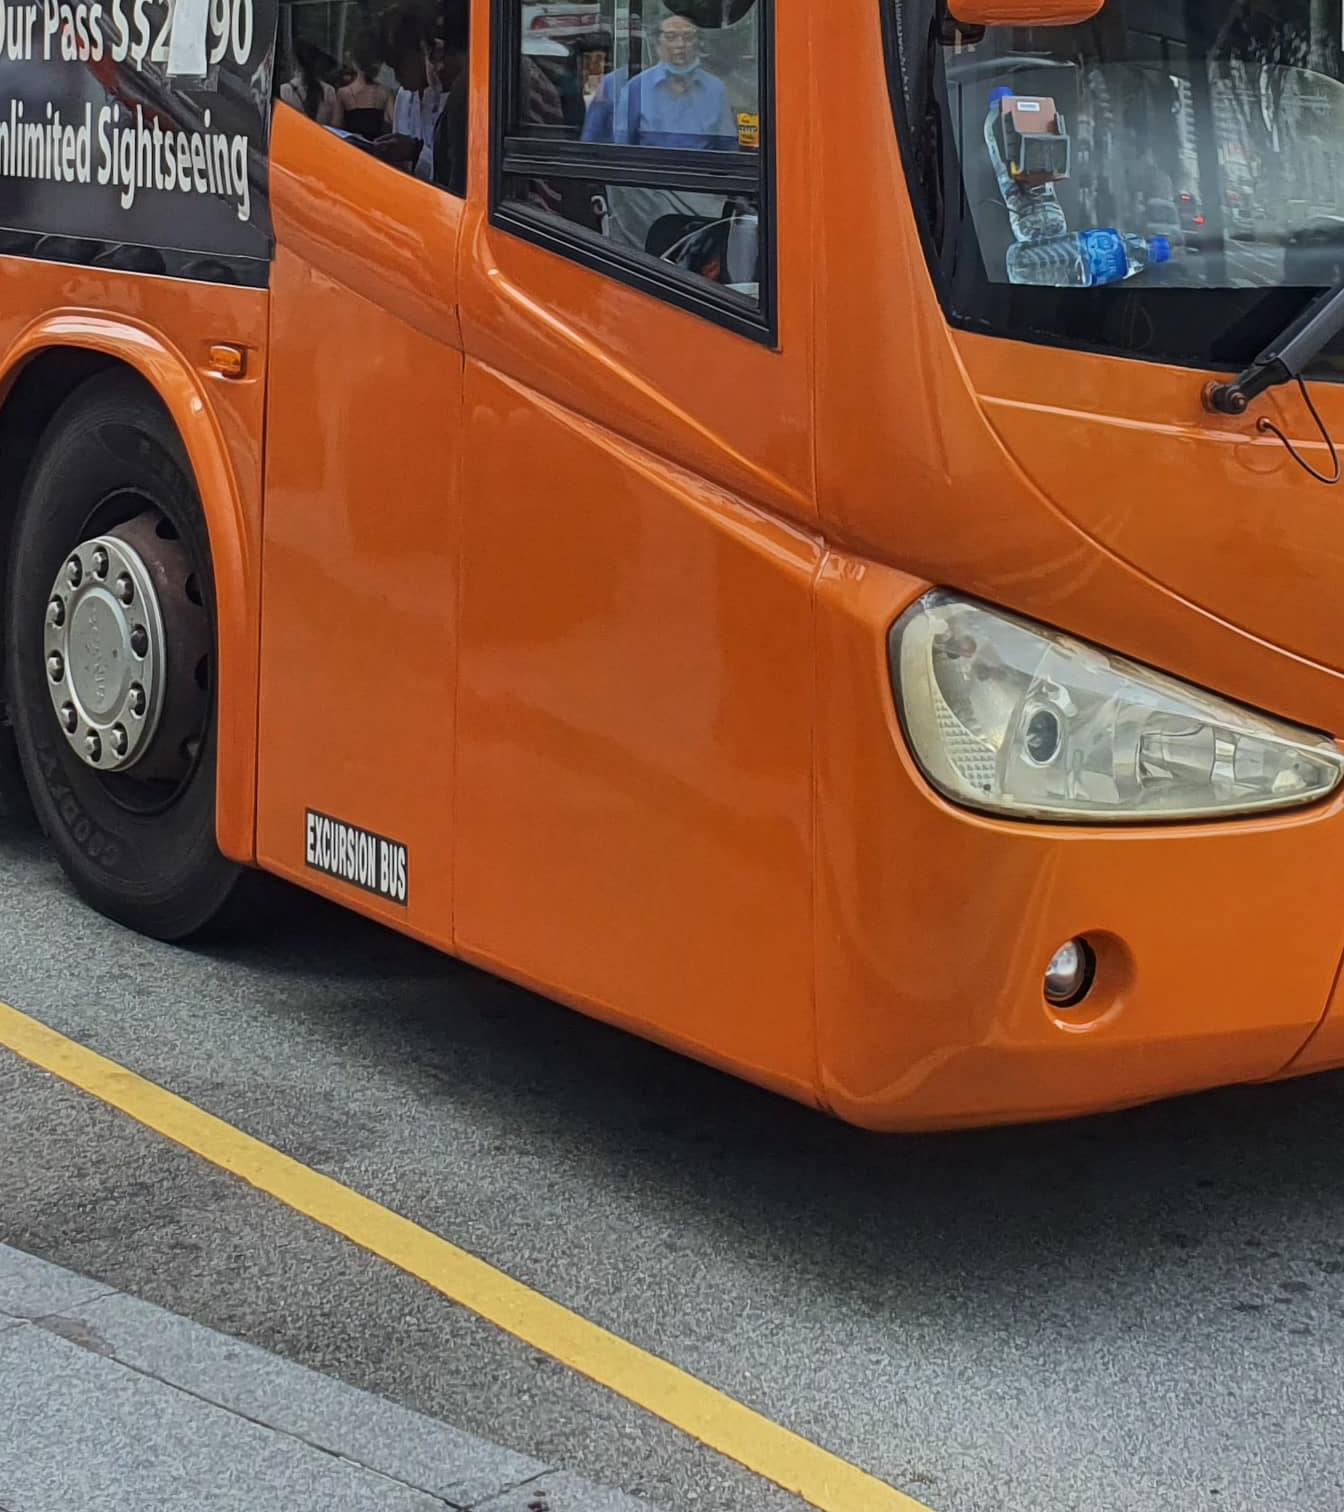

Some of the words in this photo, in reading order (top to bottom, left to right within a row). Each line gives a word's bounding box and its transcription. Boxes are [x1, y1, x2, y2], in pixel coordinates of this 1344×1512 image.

[97, 104, 250, 221] Sightseeing
[307, 812, 376, 889] EXCURSION
[380, 839, 406, 901] BUS
